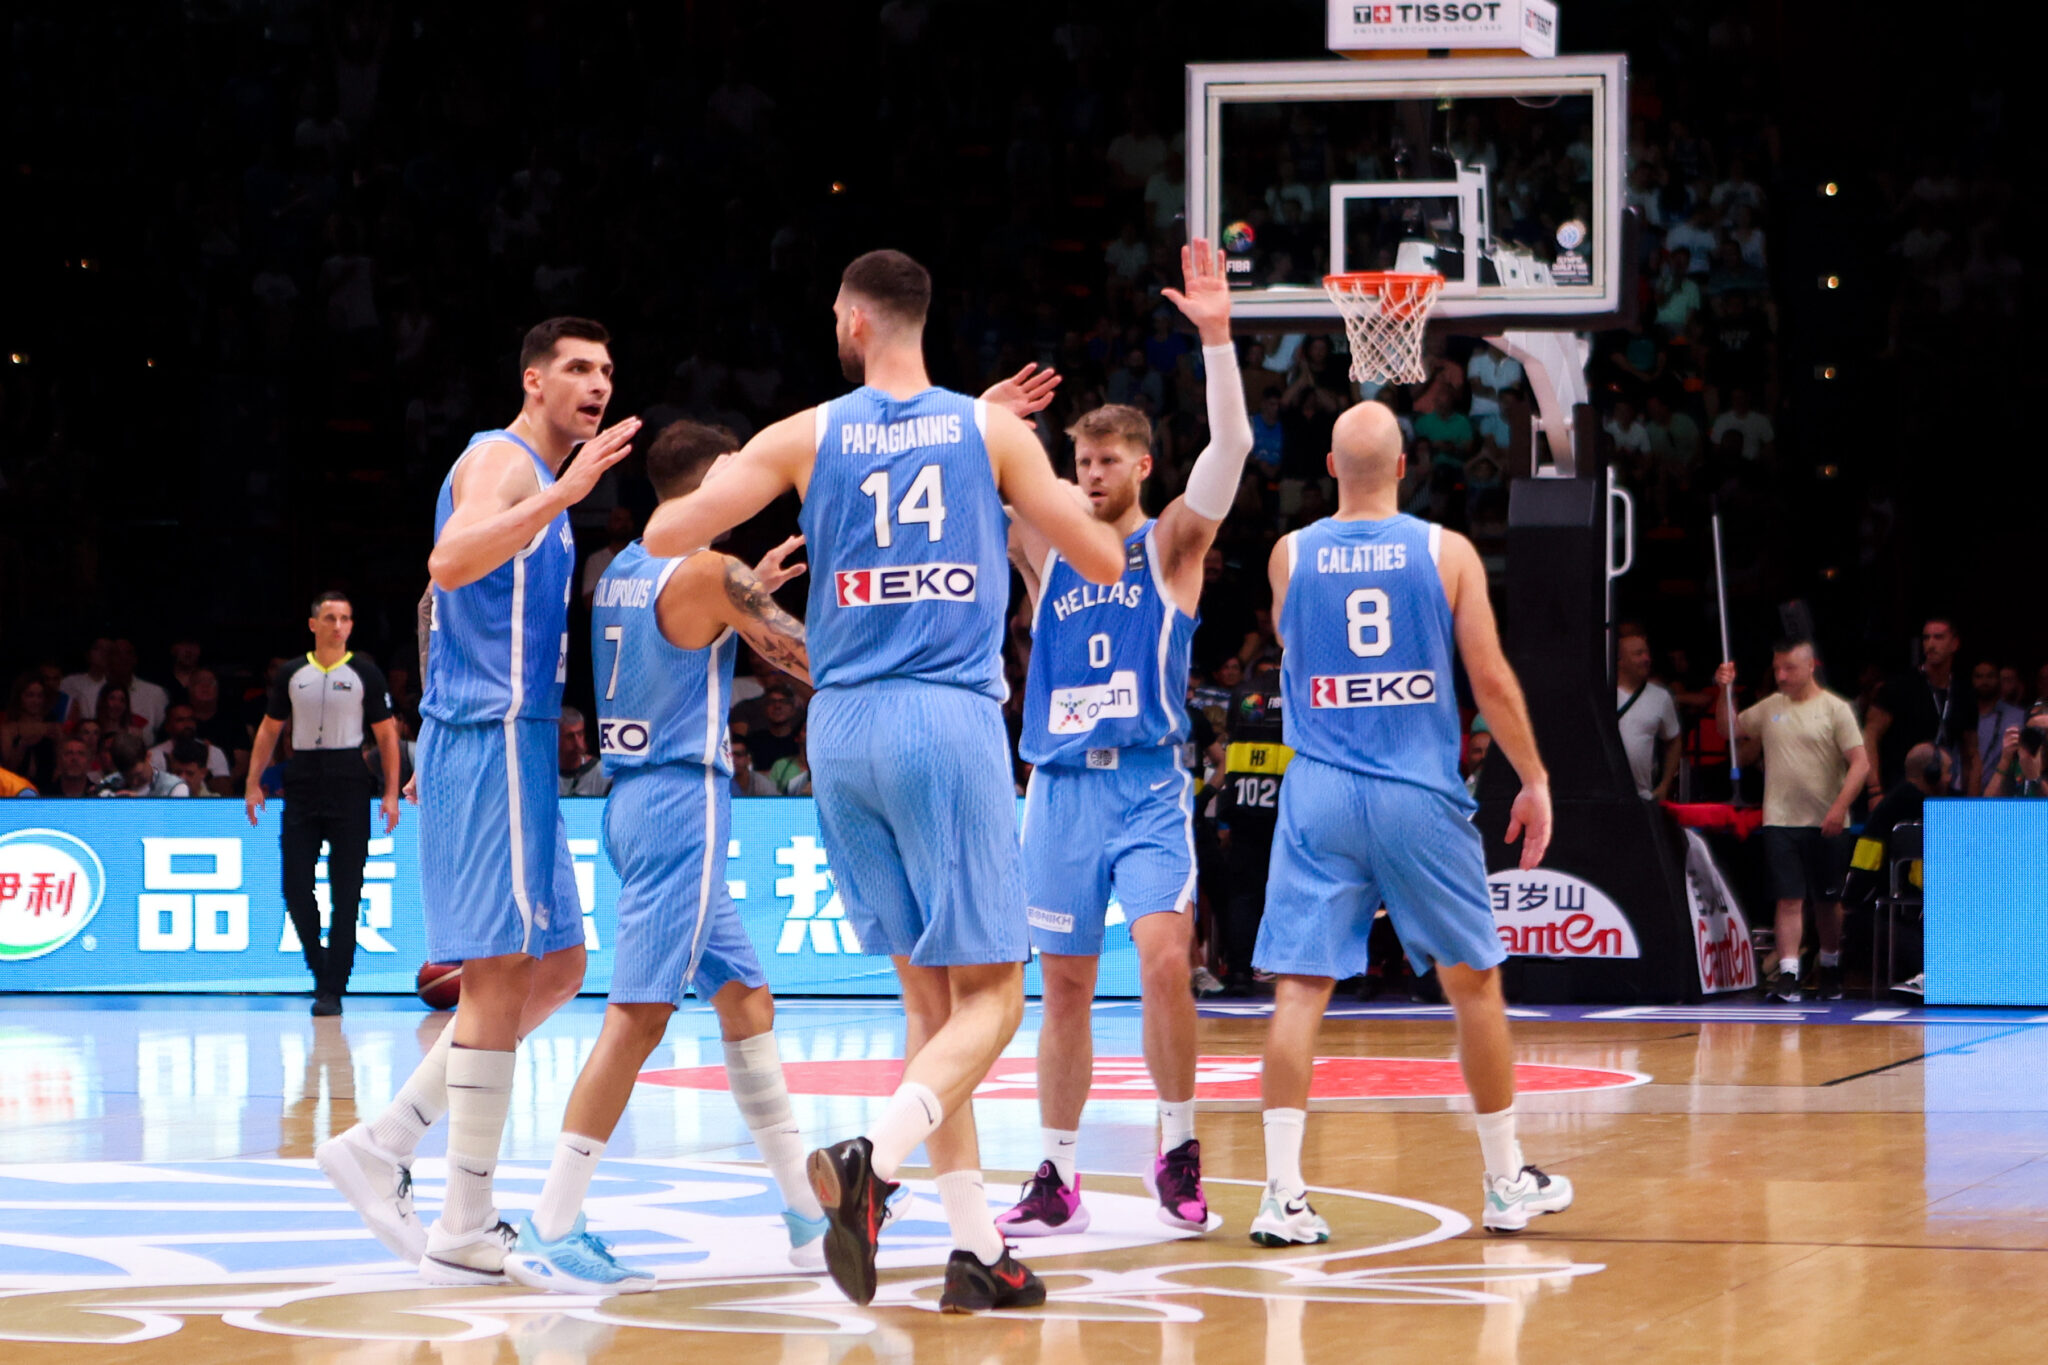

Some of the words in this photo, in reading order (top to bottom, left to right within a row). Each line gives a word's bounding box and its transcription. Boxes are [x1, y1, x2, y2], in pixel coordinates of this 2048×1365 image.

[1397, 3, 1501, 22] TISSOT
[1226, 259, 1251, 273] FIBA
[841, 414, 962, 455] PAPAGIANNIS
[859, 464, 946, 548] 14
[1317, 544, 1407, 574] CALATHES
[880, 568, 975, 600] EKO
[1053, 581, 1143, 622] HELLAS
[1345, 588, 1392, 659] 8
[605, 625, 623, 701] 7
[1088, 633, 1111, 669] 0
[1268, 697, 1282, 710] FIB
[1346, 674, 1434, 703] EKO
[1235, 778, 1277, 808] 102
[1488, 883, 1585, 911] 百岁山
[1497, 914, 1622, 956] anten
